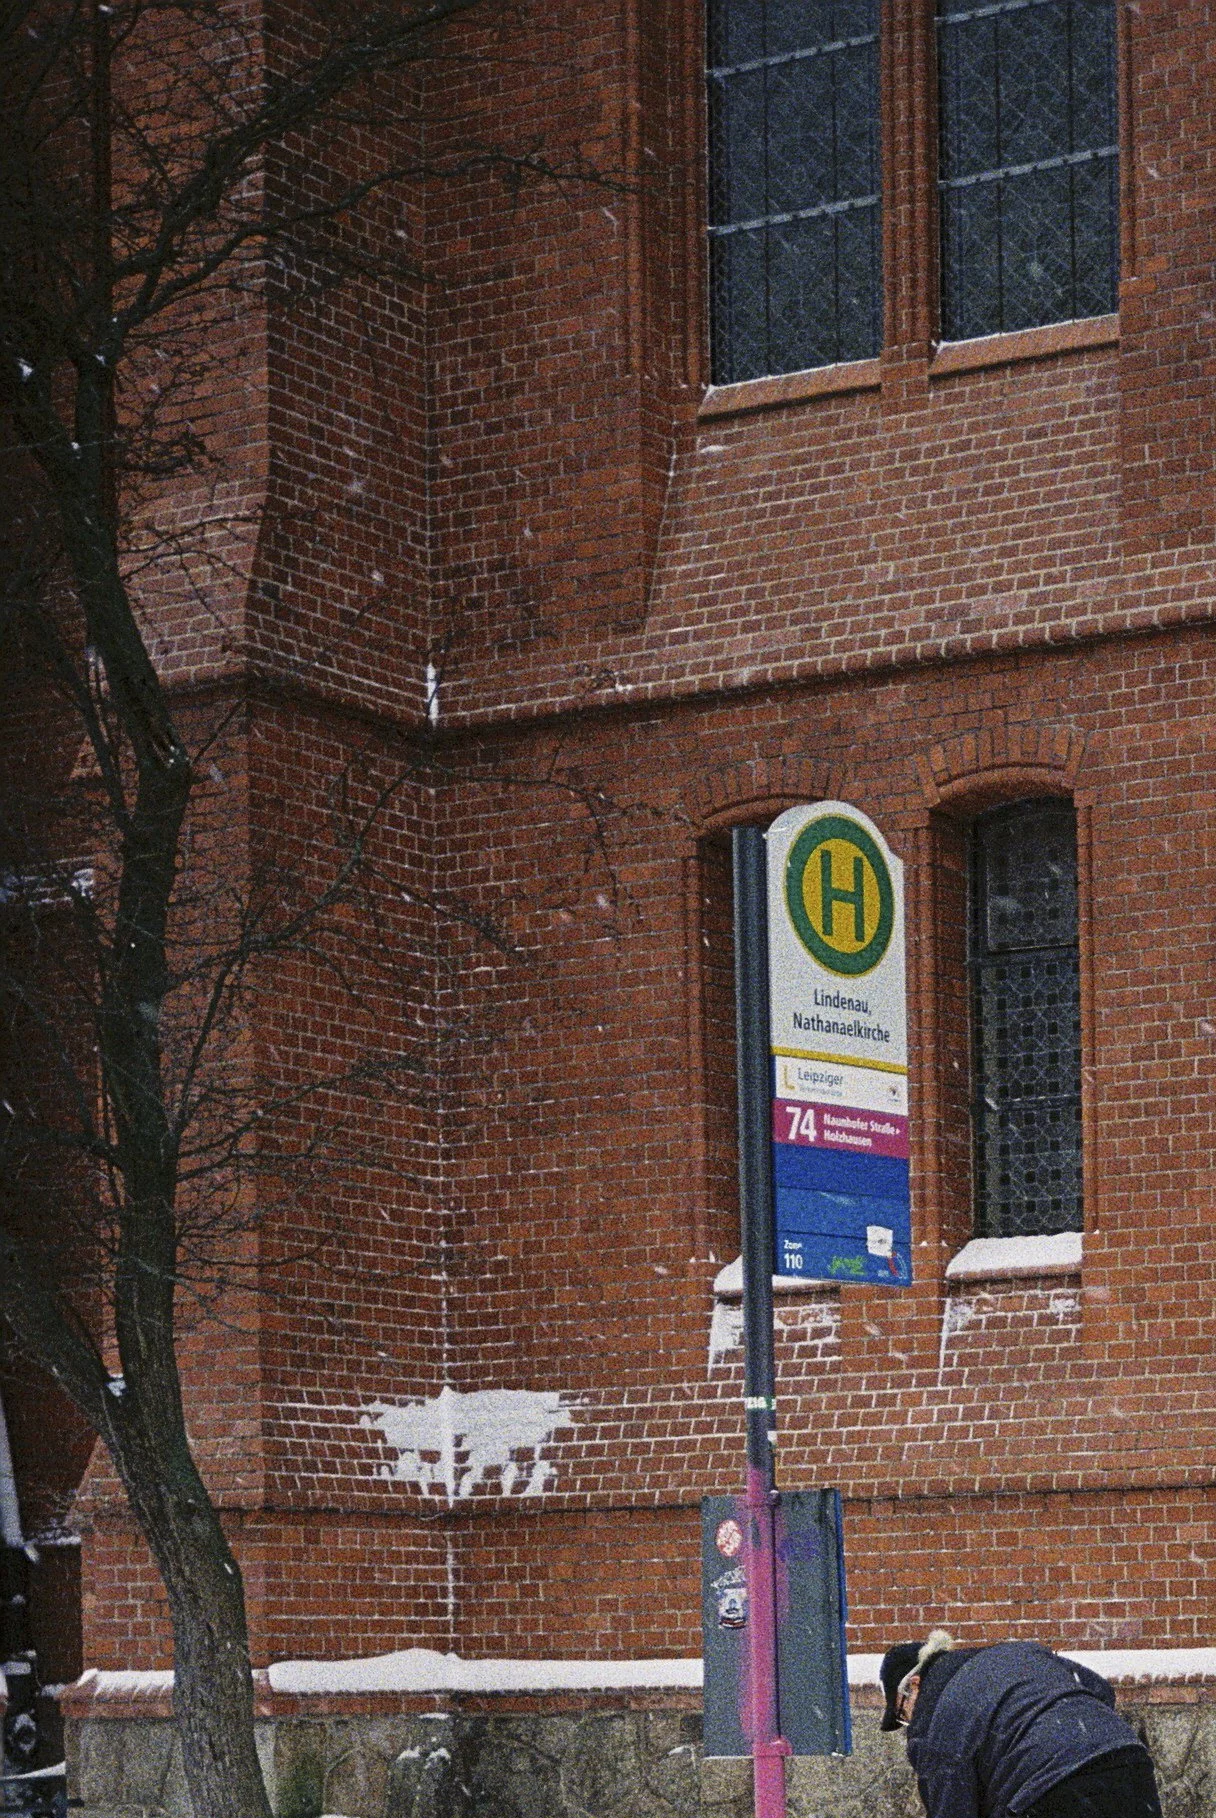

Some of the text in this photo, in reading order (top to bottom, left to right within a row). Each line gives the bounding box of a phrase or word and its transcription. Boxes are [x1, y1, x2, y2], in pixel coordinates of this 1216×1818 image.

[821, 850, 864, 942] H
[814, 987, 872, 1014] Lindenau,
[793, 1012, 890, 1043] Nathanaelkirche
[797, 1067, 844, 1087] Leipziger
[786, 1106, 817, 1143] 74
[824, 1129, 872, 1147] Holzhausen
[784, 1253, 803, 1270] 110
